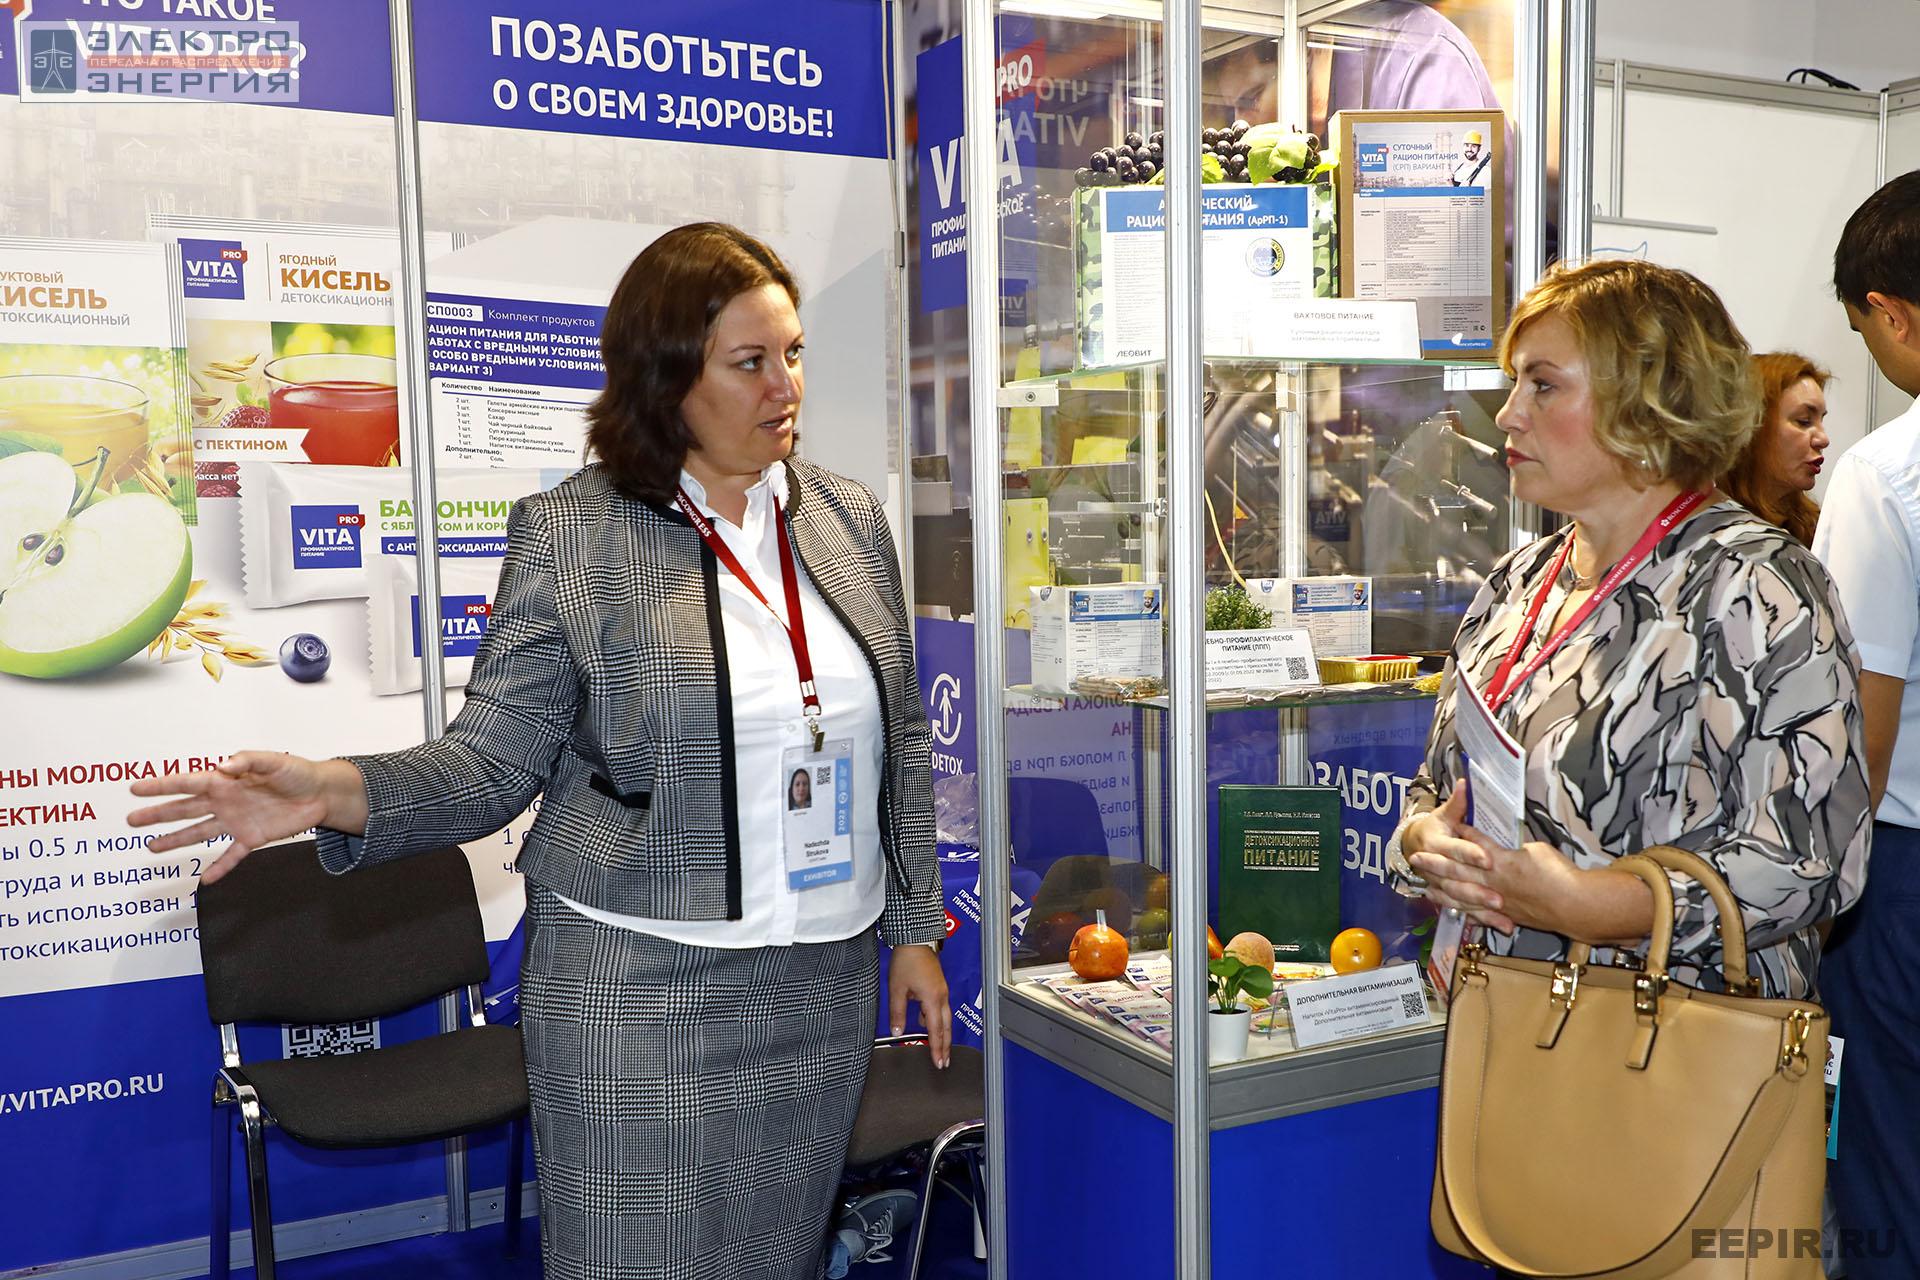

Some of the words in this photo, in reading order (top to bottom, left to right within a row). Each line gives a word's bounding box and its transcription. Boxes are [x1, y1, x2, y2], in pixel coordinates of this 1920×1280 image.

[491, 16, 823, 88] ПОЗАБОТЬТЕСЬ
[997, 54, 1033, 97] PRO
[493, 79, 518, 111] О
[528, 82, 647, 121] СВОЕМ
[657, 94, 834, 138] ЗДОРОВЬЕ!
[1393, 142, 1432, 151] СУТОЧНЫЙ
[930, 118, 1023, 210] VIA
[1362, 154, 1384, 162] VITA
[1158, 195, 1253, 211] АЧЕСКИЙ
[1127, 215, 1165, 228] РАЦИО
[1248, 215, 1288, 227] (АрРП-1)
[223, 251, 242, 259] PRO
[932, 235, 967, 259] ПИТАНИ
[279, 254, 337, 267] ЯГОДНЫЙ
[186, 260, 237, 278] VITA
[0, 271, 64, 284] УКТОВЫЙ
[281, 268, 391, 292] КИСЕЛЬ
[281, 292, 393, 308] ДЕТОКСИКАЦИОНН
[0, 311, 130, 326] ТОКСИКАЦИОННЫЙ
[488, 309, 539, 323] Комплект
[542, 315, 595, 327] продуктов
[1338, 312, 1374, 320] ПИТАНИЕ
[428, 324, 467, 335] АЦИОН
[470, 327, 522, 340] ПИТАНИЯ
[524, 332, 548, 343] ДЛЯ
[550, 334, 602, 346] РАБОТНИ
[428, 337, 472, 349] АБОТАХ
[474, 341, 481, 350] С
[484, 341, 549, 355] ВРЕДНЫМИ
[551, 347, 602, 359] УСЛОВИЯ
[433, 350, 468, 361] ОСОБО
[471, 353, 536, 366] ВРЕДНЫМИ
[429, 362, 480, 375] ВАРИАНТ
[482, 366, 493, 376] 3)
[442, 382, 483, 391] Количество
[489, 386, 540, 396] Наименование
[206, 440, 288, 450] ПЕКТИНОМ
[446, 445, 502, 455] Дополнительно:
[339, 516, 359, 524] PRO
[381, 522, 388, 530] С
[464, 522, 475, 530] И
[477, 522, 508, 531] КОРИ
[300, 529, 354, 545] VITA
[387, 543, 395, 552] С
[467, 606, 487, 614] PRO
[1206, 635, 1294, 645] ЕБНО-ПРОФИЛАКТИЧЕСКОЕ
[1222, 644, 1252, 652] ПИТАНИЕ
[932, 753, 963, 776] DETOX
[0, 767, 38, 789] НЫ
[50, 761, 157, 786] МОЛОКА
[163, 758, 180, 777] И
[0, 802, 97, 827] ЕКТИНА
[29, 838, 65, 859] 0.5
[74, 839, 88, 855] л
[1244, 835, 1320, 847] ДЕТОКСИКАЦИОННОЕ
[1244, 849, 1320, 866] ПИТАНИЕ
[71, 873, 84, 888] и
[94, 864, 181, 889] выдачи
[803, 869, 837, 882] EXHIBITOR
[28, 896, 180, 927] использован
[1296, 988, 1358, 1005] ДОПОЛНИТЕЛЬНАЯ
[1358, 977, 1413, 993] ВИТАМИНИЗАЦИЯ
